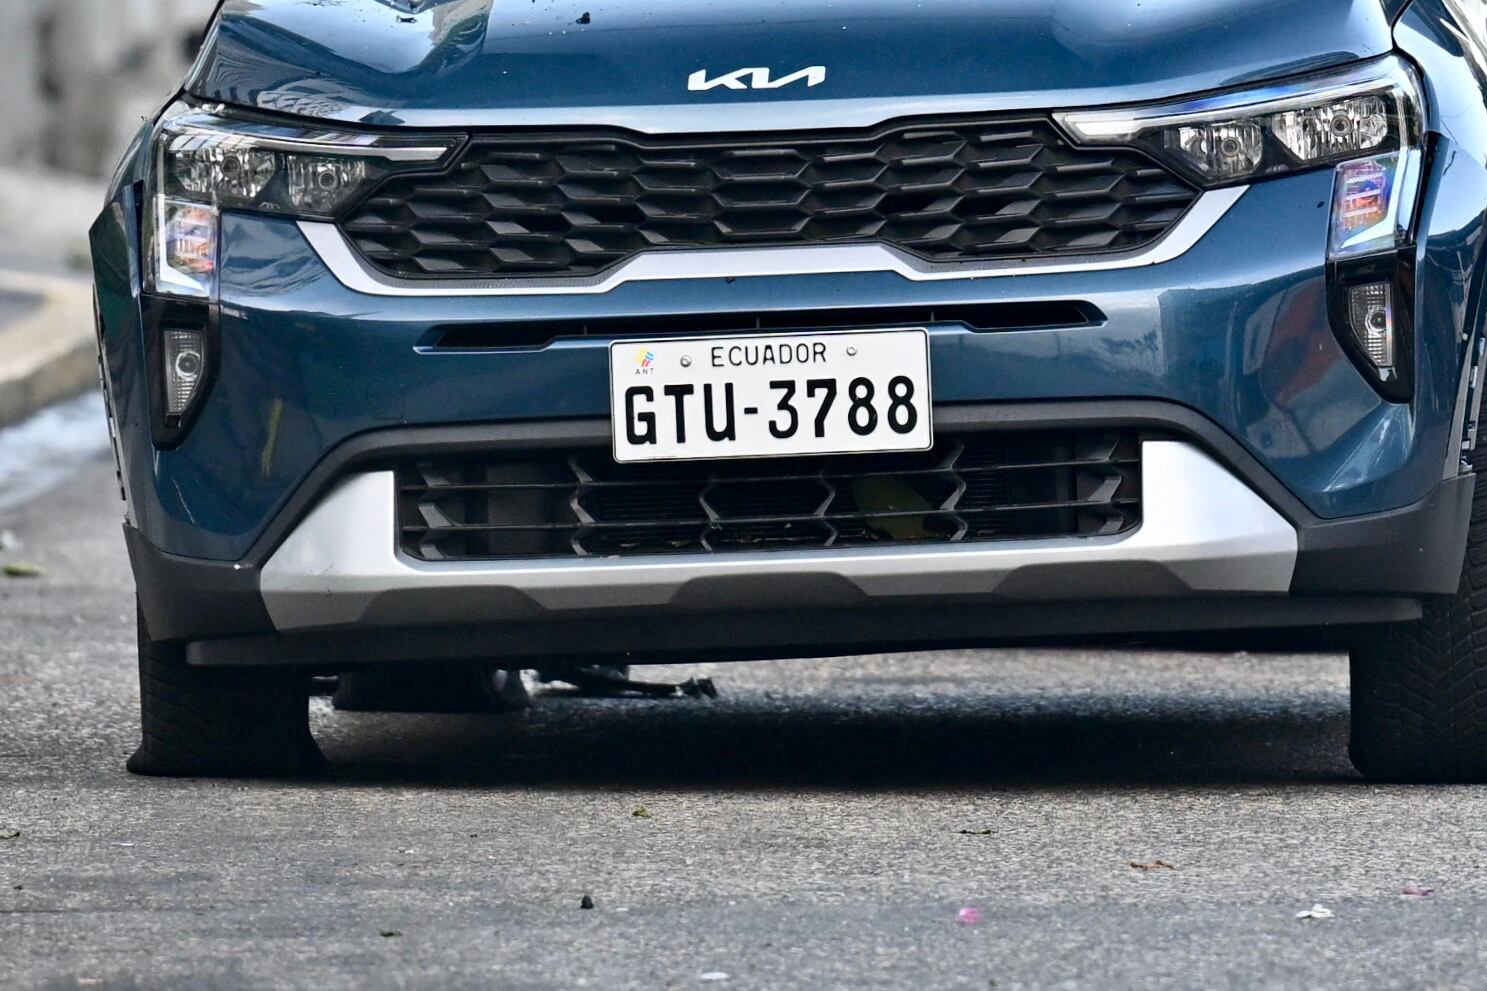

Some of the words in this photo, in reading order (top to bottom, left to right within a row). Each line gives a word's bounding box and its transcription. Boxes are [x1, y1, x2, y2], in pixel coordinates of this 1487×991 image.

[687, 65, 826, 91] KIA
[711, 342, 827, 368] ECUADOR
[634, 367, 655, 375] ANT
[624, 375, 918, 446] GTU-3788
